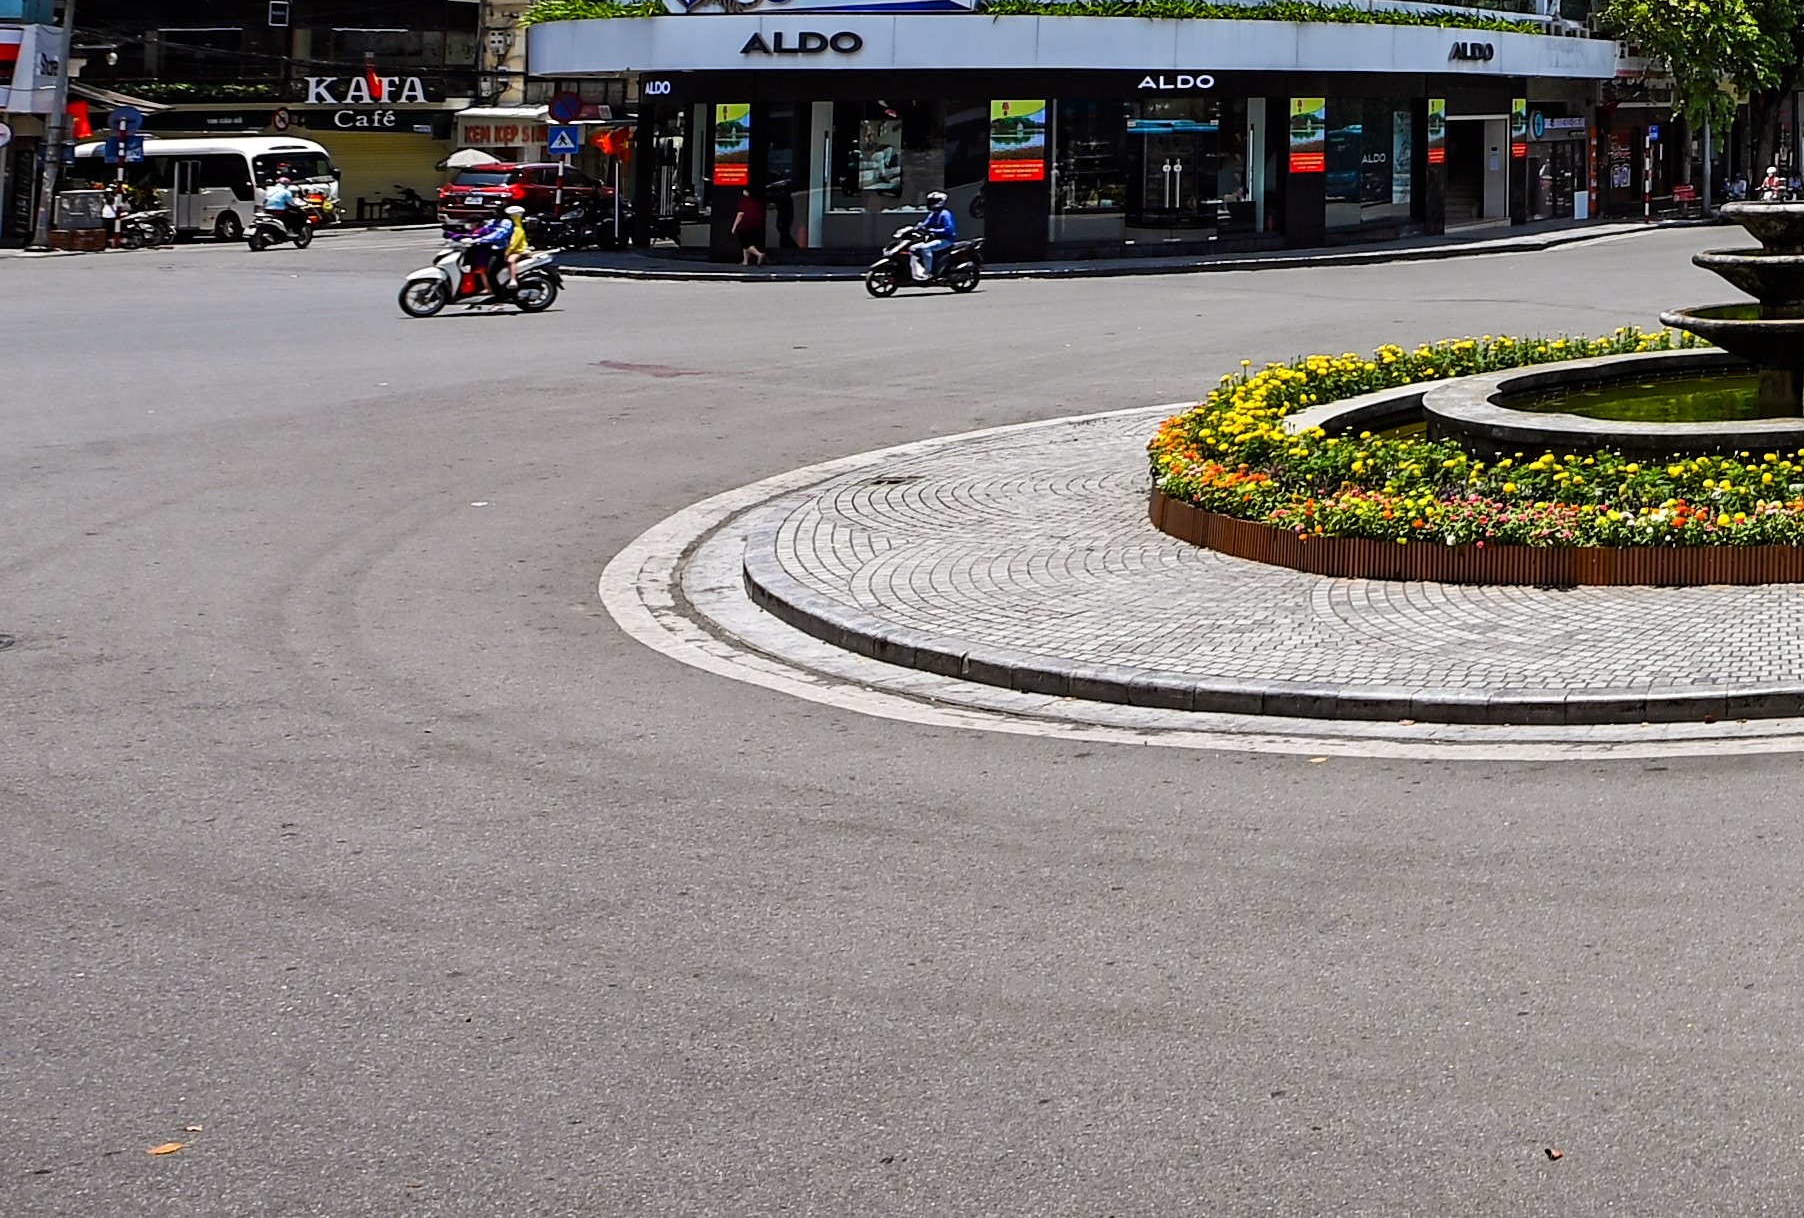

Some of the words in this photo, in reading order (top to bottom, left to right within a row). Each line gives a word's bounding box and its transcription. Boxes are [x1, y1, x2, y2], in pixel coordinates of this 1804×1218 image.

[739, 30, 864, 55] ALDO
[1447, 41, 1495, 62] ALDO
[303, 76, 429, 105] KAFA
[644, 81, 671, 95] ALDO
[1137, 74, 1215, 90] ALDO
[334, 109, 397, 128] Café
[1361, 152, 1387, 164] ALDO
